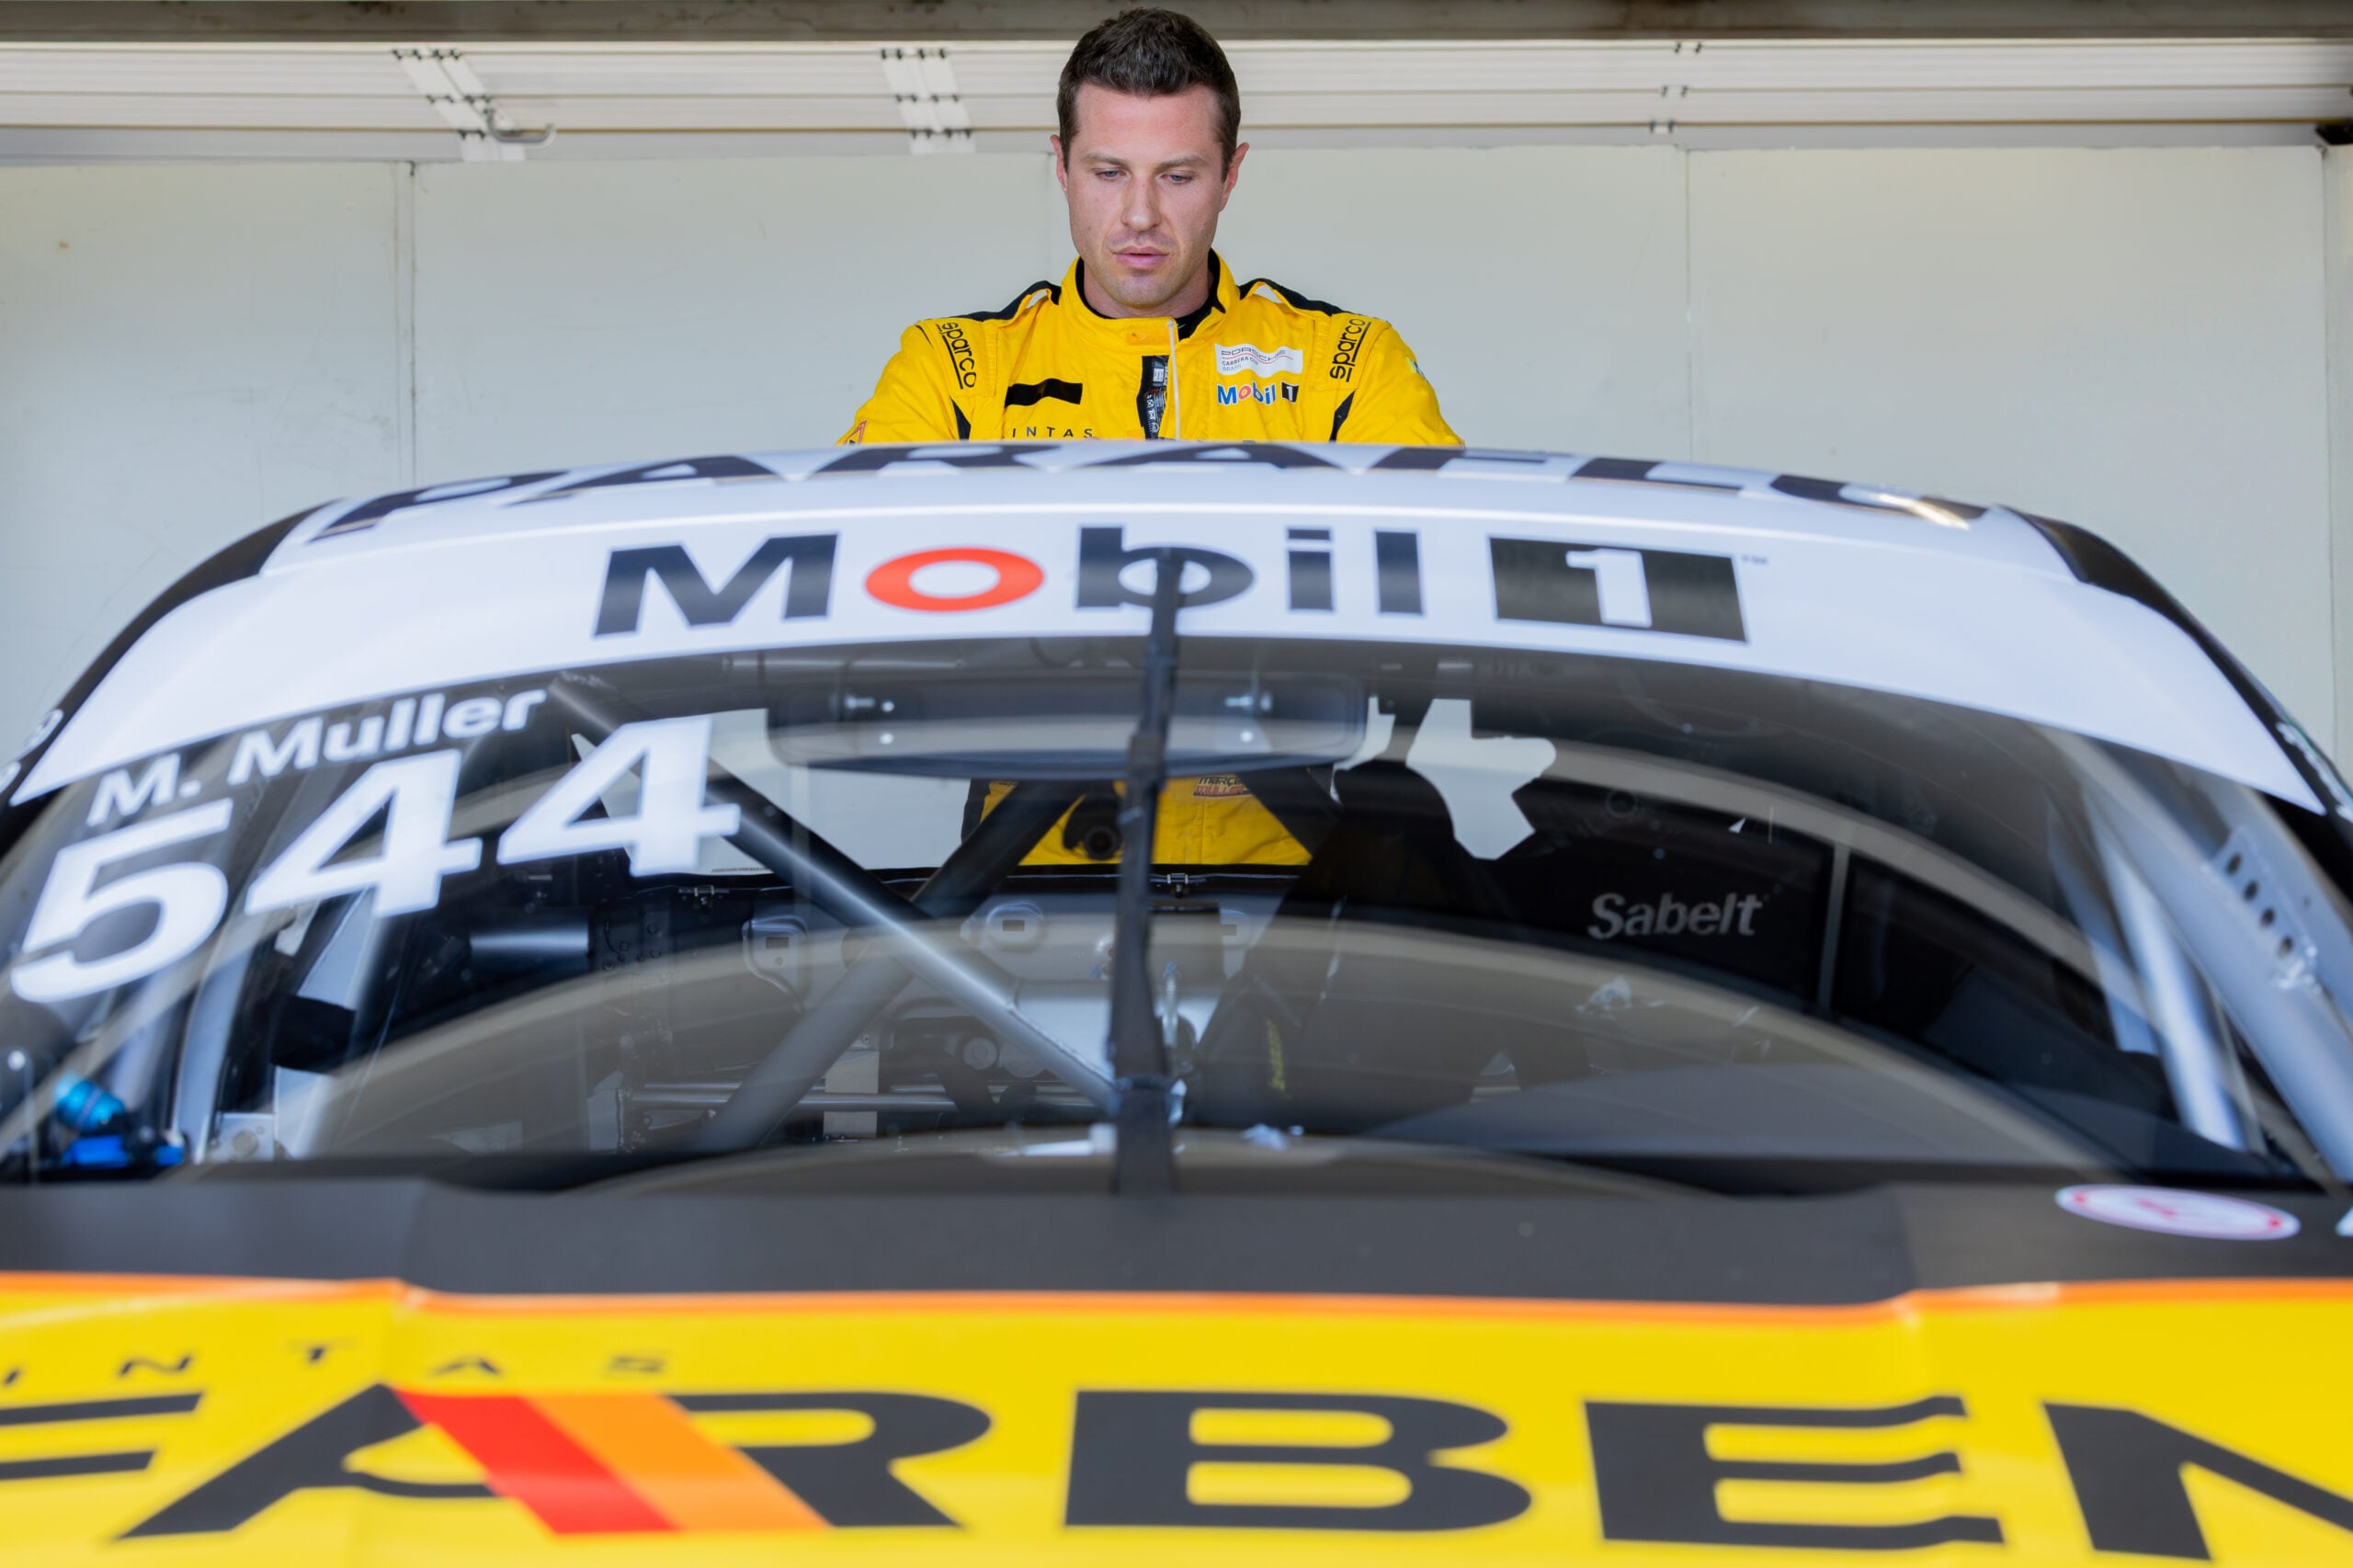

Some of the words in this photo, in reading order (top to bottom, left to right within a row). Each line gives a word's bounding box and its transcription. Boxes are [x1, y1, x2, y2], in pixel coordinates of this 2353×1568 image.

[936, 323, 977, 389] sparco
[1329, 318, 1371, 382] sparco
[1217, 381, 1276, 405] Mobil
[594, 525, 1424, 639] Mobil
[87, 752, 202, 825] M.
[228, 689, 546, 784] Muller
[10, 716, 742, 1002] 544
[1587, 892, 1764, 940] Sabelt
